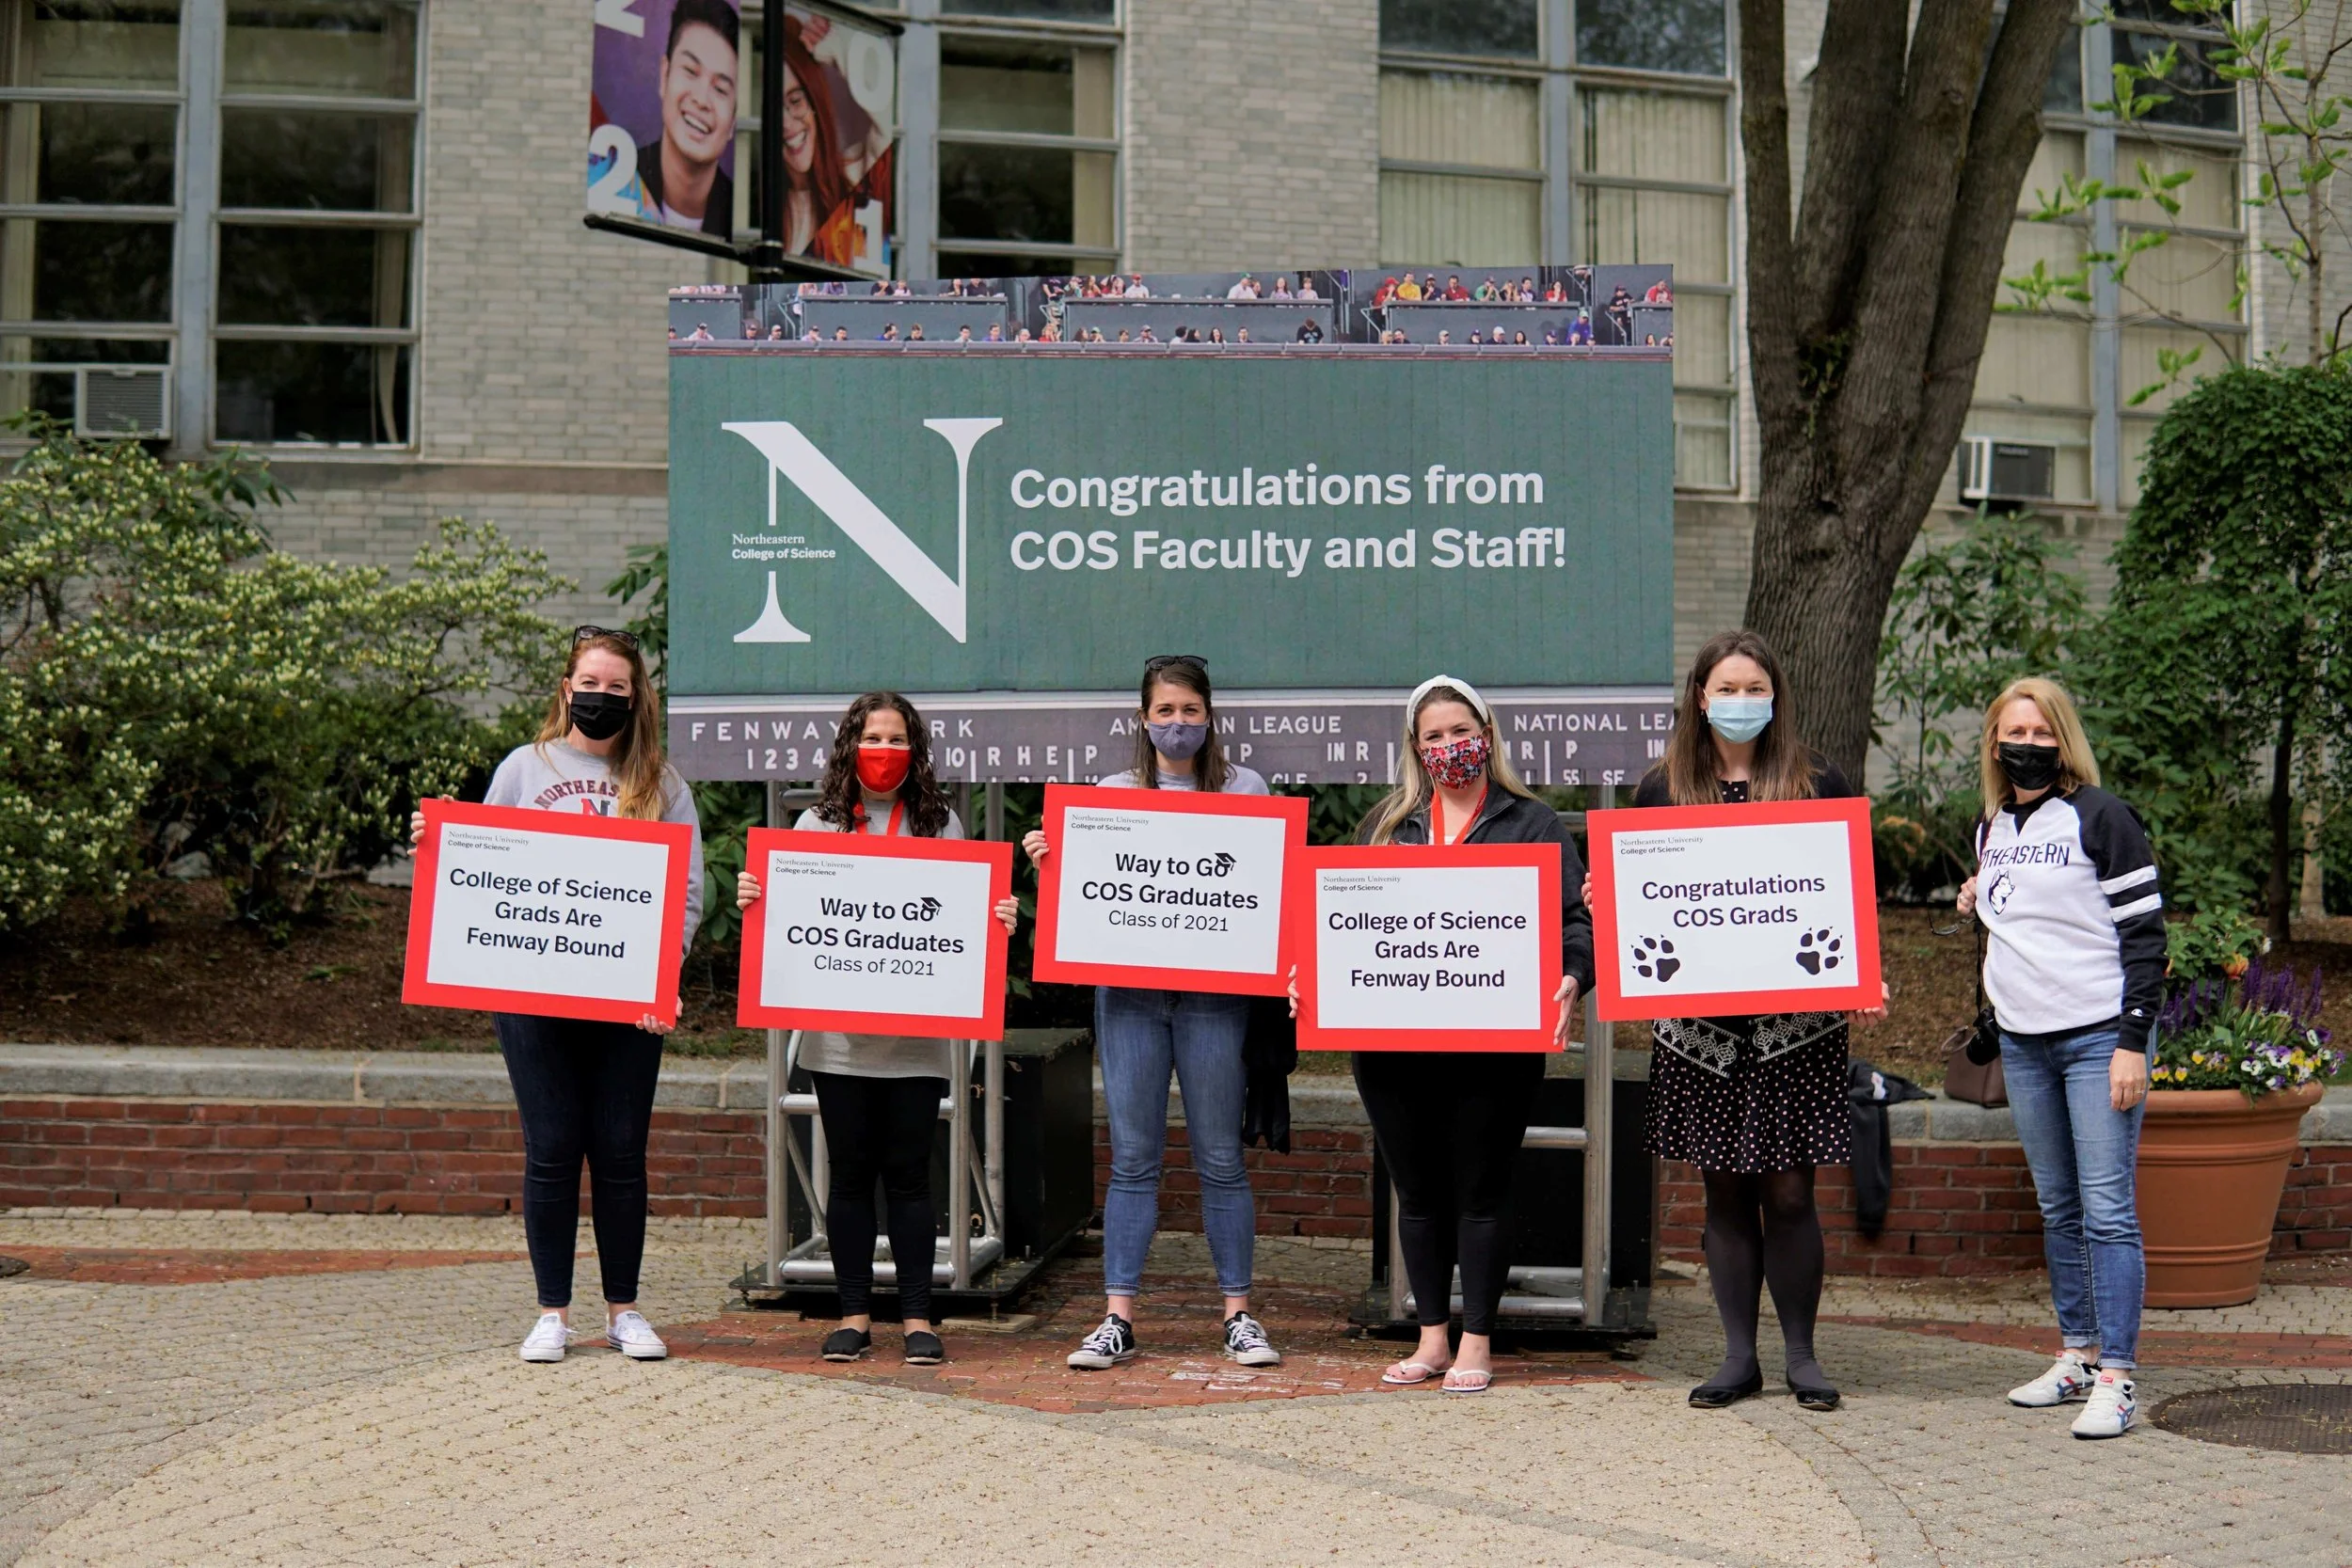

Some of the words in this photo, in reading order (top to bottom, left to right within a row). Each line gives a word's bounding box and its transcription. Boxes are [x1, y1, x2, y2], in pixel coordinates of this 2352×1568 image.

[588, 123, 638, 214] 2
[1010, 463, 1411, 516] Congratulations
[1424, 465, 1544, 504] from
[722, 418, 1003, 643] N
[732, 533, 804, 545] Northeastern
[732, 548, 774, 561] College
[776, 548, 789, 559] of
[790, 547, 835, 559] Science
[1010, 531, 1119, 570] COS
[1134, 530, 1311, 578] Faculty
[1324, 530, 1415, 568] and
[1430, 528, 1566, 567] Staff!
[691, 721, 841, 741] FENWAY
[930, 719, 974, 738] RK
[1249, 716, 1342, 734] LEAGUE
[1514, 714, 1628, 732] NATIONAL
[765, 749, 777, 769] 2
[786, 748, 799, 770] 3
[812, 748, 826, 768] 4
[946, 747, 965, 768] 10
[988, 747, 1001, 767] R
[1018, 746, 1030, 766] H
[1047, 746, 1057, 765] E
[1085, 745, 1097, 765] P
[1240, 743, 1252, 763] P
[1327, 742, 1345, 762] IN
[1356, 741, 1369, 761] R
[1521, 740, 1534, 760] R
[1565, 740, 1578, 759] P
[533, 780, 620, 810] NORTHEAS
[1071, 822, 1095, 831] College
[1072, 814, 1114, 823] Northeastern
[1116, 816, 1149, 825] University
[448, 840, 473, 848] College
[449, 831, 492, 842] Northeastern
[495, 835, 529, 846] University
[1620, 838, 1665, 847] Northeastern
[1668, 835, 1704, 845] University
[775, 866, 801, 875] College
[776, 858, 818, 867] Northeastern
[821, 861, 854, 869] University
[1116, 853, 1161, 878] Way
[1167, 857, 1189, 875] to
[1196, 858, 1229, 878] Go
[450, 868, 532, 895] College
[538, 878, 561, 895] of
[565, 879, 652, 904] Science
[1367, 876, 1401, 884] University
[1642, 874, 1825, 902] Congratulations
[1082, 881, 1133, 902] COS
[1139, 884, 1259, 909] Graduates
[495, 901, 560, 924] Grads
[565, 908, 602, 927] Are
[820, 897, 867, 922] Way
[872, 901, 896, 920] to
[901, 901, 935, 922] Go
[1674, 908, 1724, 927] COS
[1729, 905, 1798, 925] Grads
[1108, 911, 1156, 927] Class
[1162, 914, 1180, 928] of
[1184, 914, 1229, 932] 2021
[1328, 912, 1407, 934] College
[1413, 911, 1436, 929] of
[1440, 911, 1527, 929] Science
[468, 927, 548, 955] Fenway
[554, 935, 625, 958] Bound
[787, 926, 838, 946] COS
[845, 929, 964, 953] Graduates
[1375, 941, 1438, 958] Grads
[1443, 941, 1480, 958] Are
[814, 955, 862, 972] Class
[867, 958, 886, 973] of
[891, 959, 934, 975] 2021
[1351, 970, 1430, 991] Fenway
[1436, 969, 1504, 988] Bound
